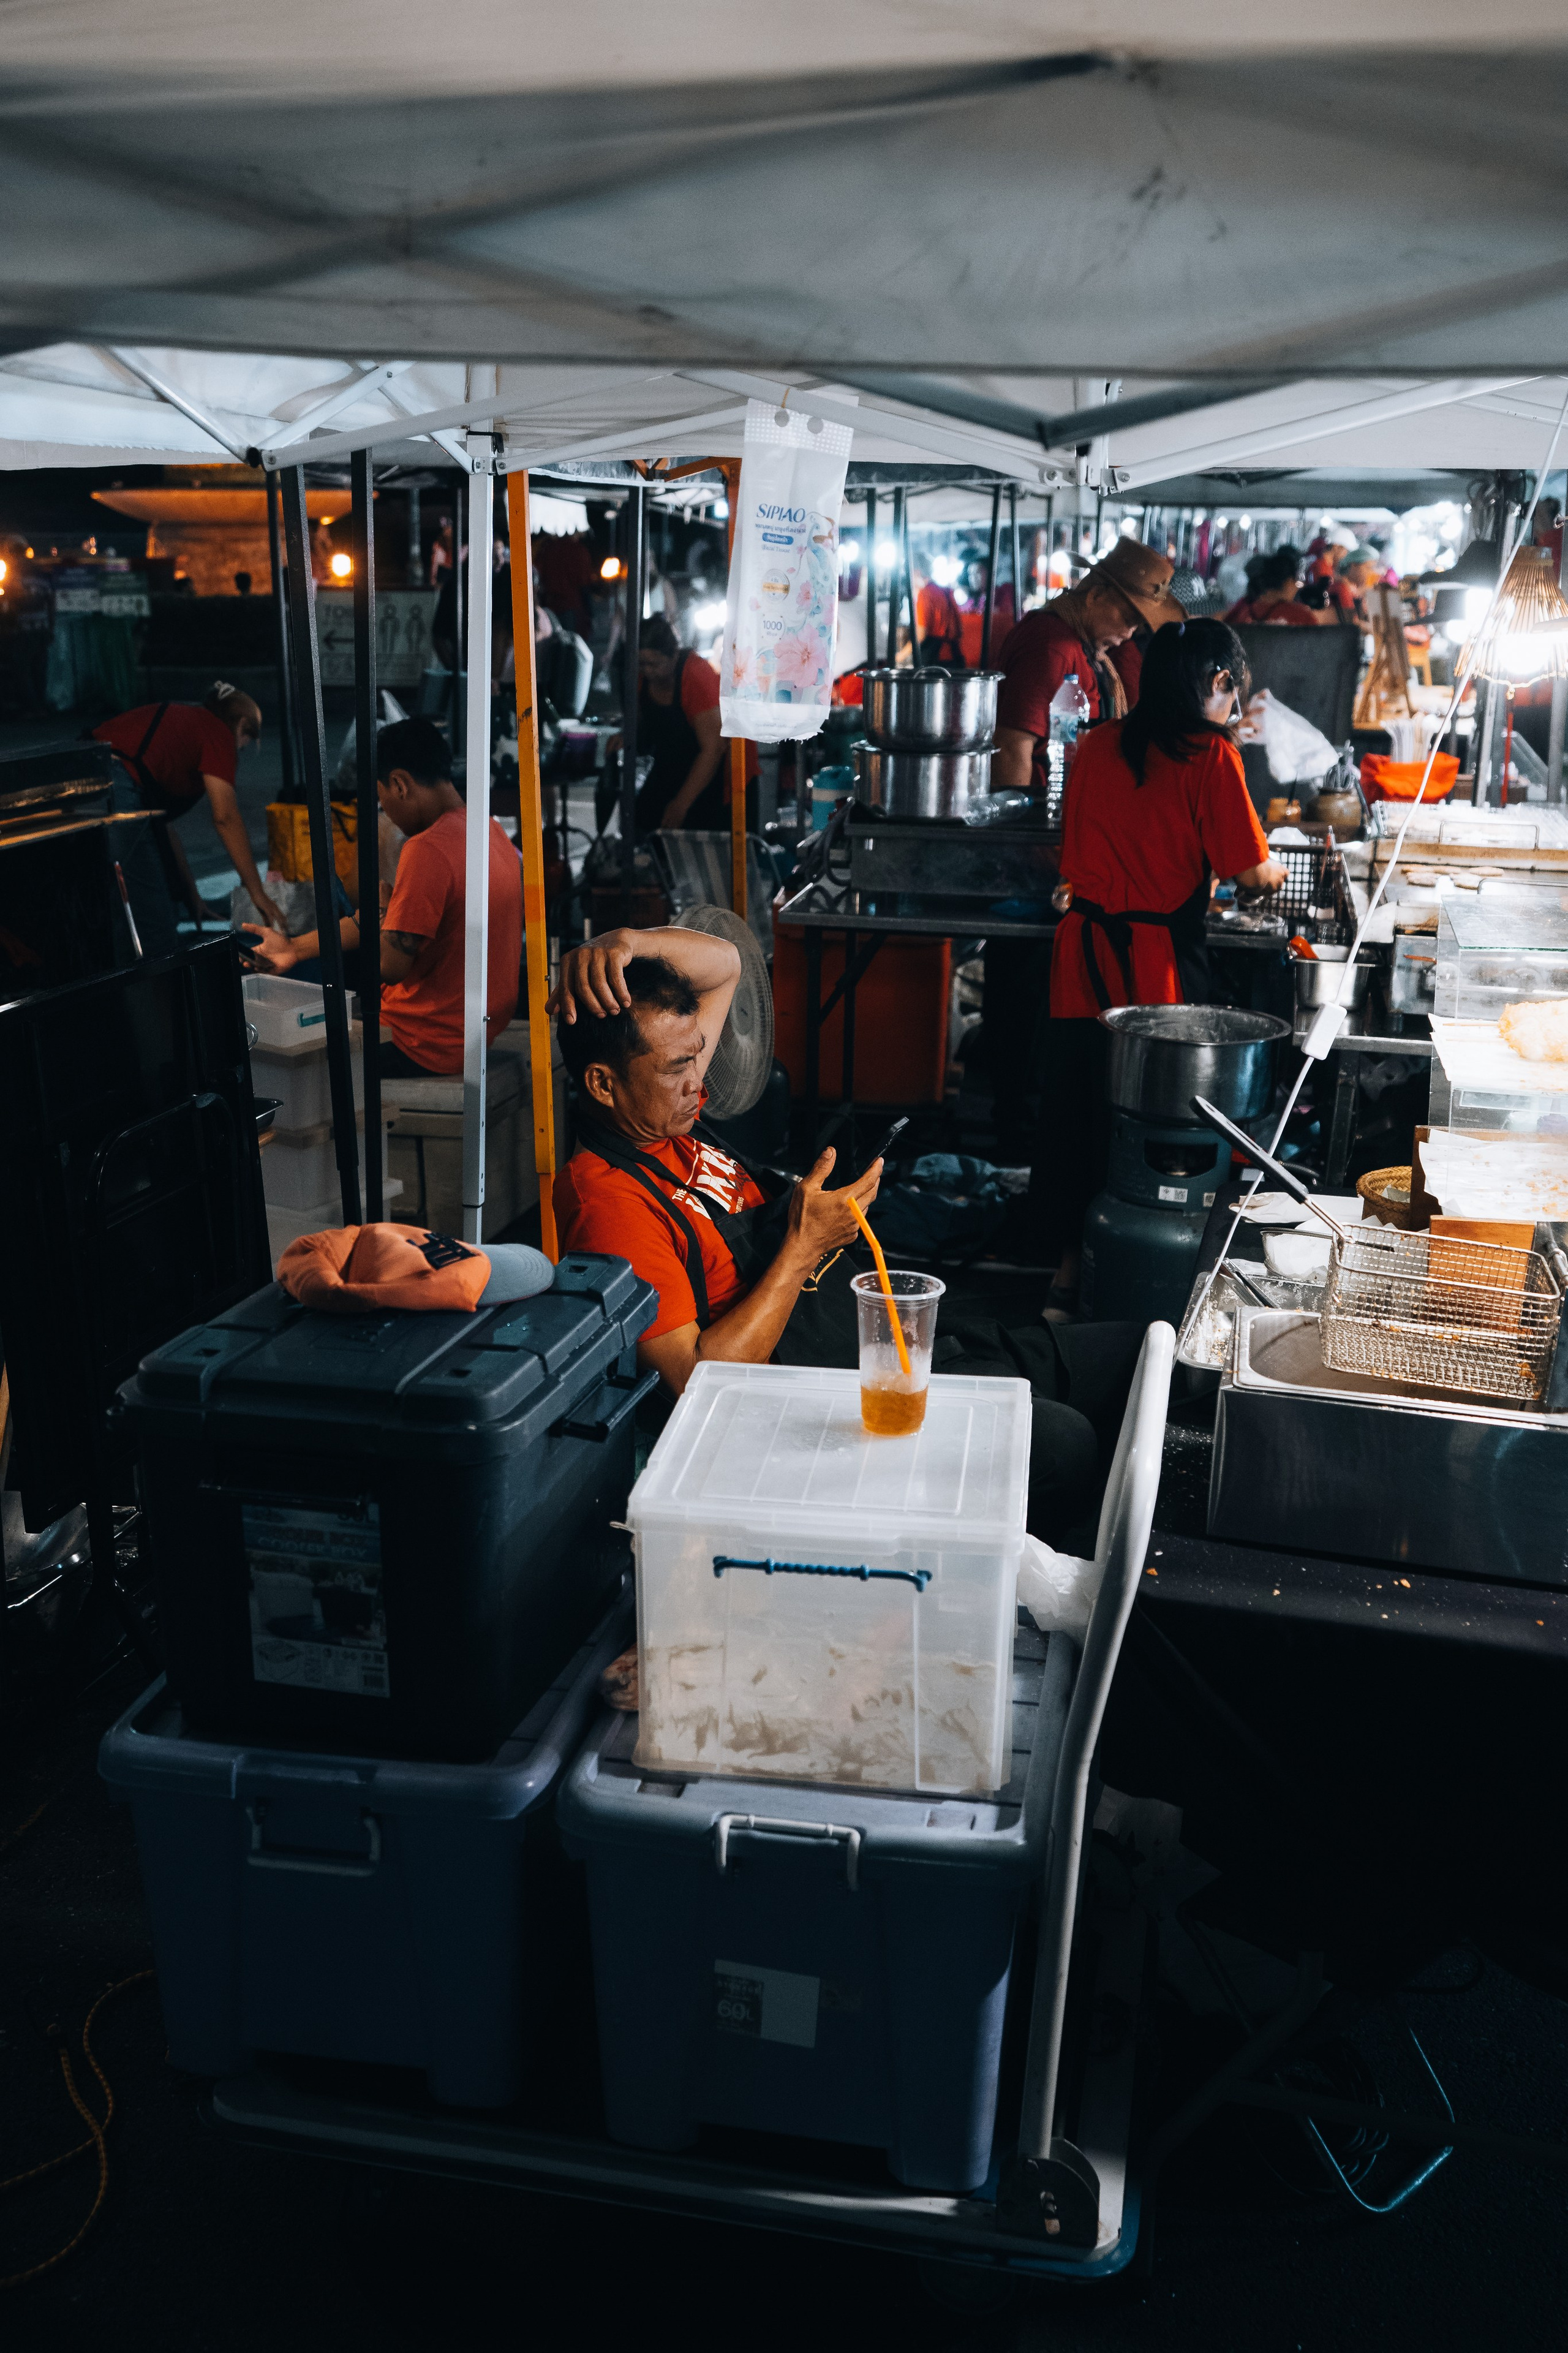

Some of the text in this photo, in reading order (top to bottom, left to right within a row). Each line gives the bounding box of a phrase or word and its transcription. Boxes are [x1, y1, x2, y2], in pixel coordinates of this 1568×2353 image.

[756, 504, 805, 523] SIPIAO
[763, 621, 782, 630] 1000
[672, 1187, 687, 1201] THE
